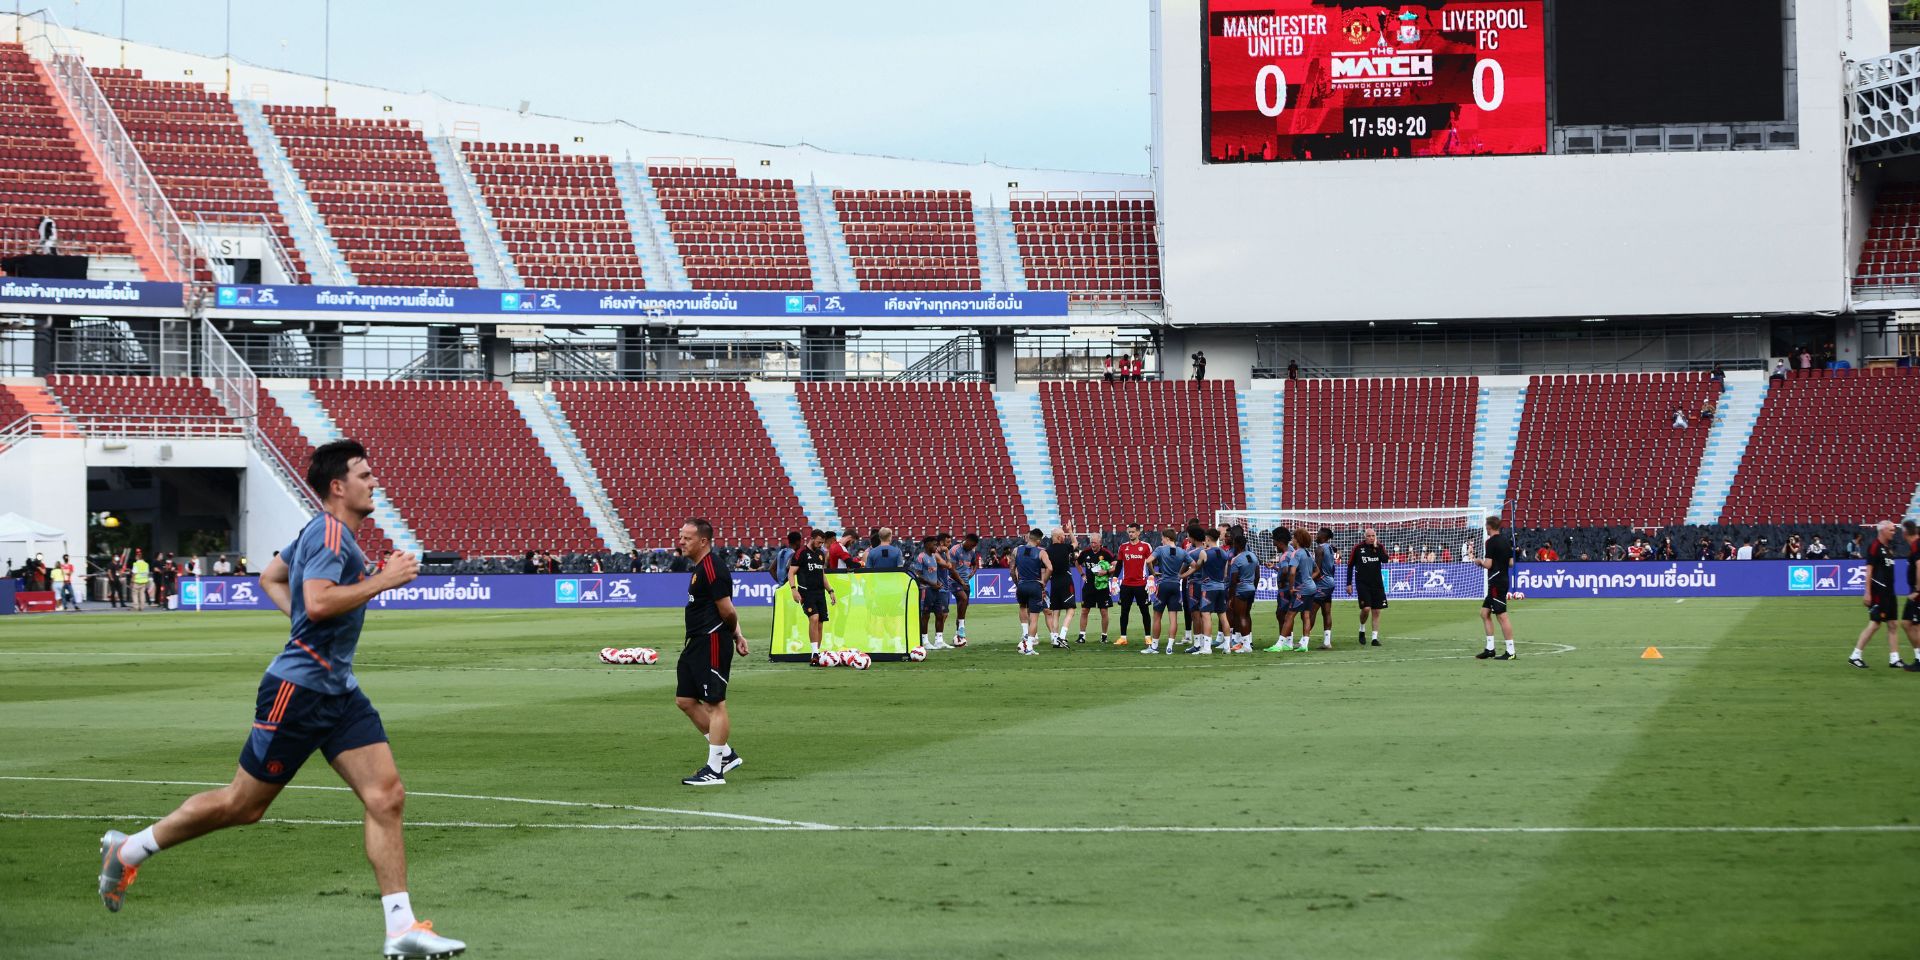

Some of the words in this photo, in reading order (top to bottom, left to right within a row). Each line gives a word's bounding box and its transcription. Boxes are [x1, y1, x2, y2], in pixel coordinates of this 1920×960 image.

[1223, 15, 1327, 38] MANCHESTER
[1442, 9, 1528, 31] LIVERPOOL
[1247, 36, 1304, 57] UNITED
[1479, 30, 1499, 50] FC
[1370, 47, 1394, 55] THE
[1331, 56, 1433, 77] MATCH
[1255, 64, 1287, 117] 0
[1331, 82, 1371, 90] BANGKOK
[1363, 88, 1401, 98] 2022
[1472, 58, 1504, 111] 0
[1349, 116, 1427, 138] 17:59:20
[220, 239, 241, 255] S1
[316, 289, 454, 310] เคียงข้างทุกความเชื่อมั่น
[600, 293, 738, 310] เคียงข้างทกความเชื่อมั่น
[884, 293, 1023, 314] เคียงข้างทุกความเชื่อมั่น
[608, 579, 631, 597] 25
[1422, 569, 1447, 588] 25
